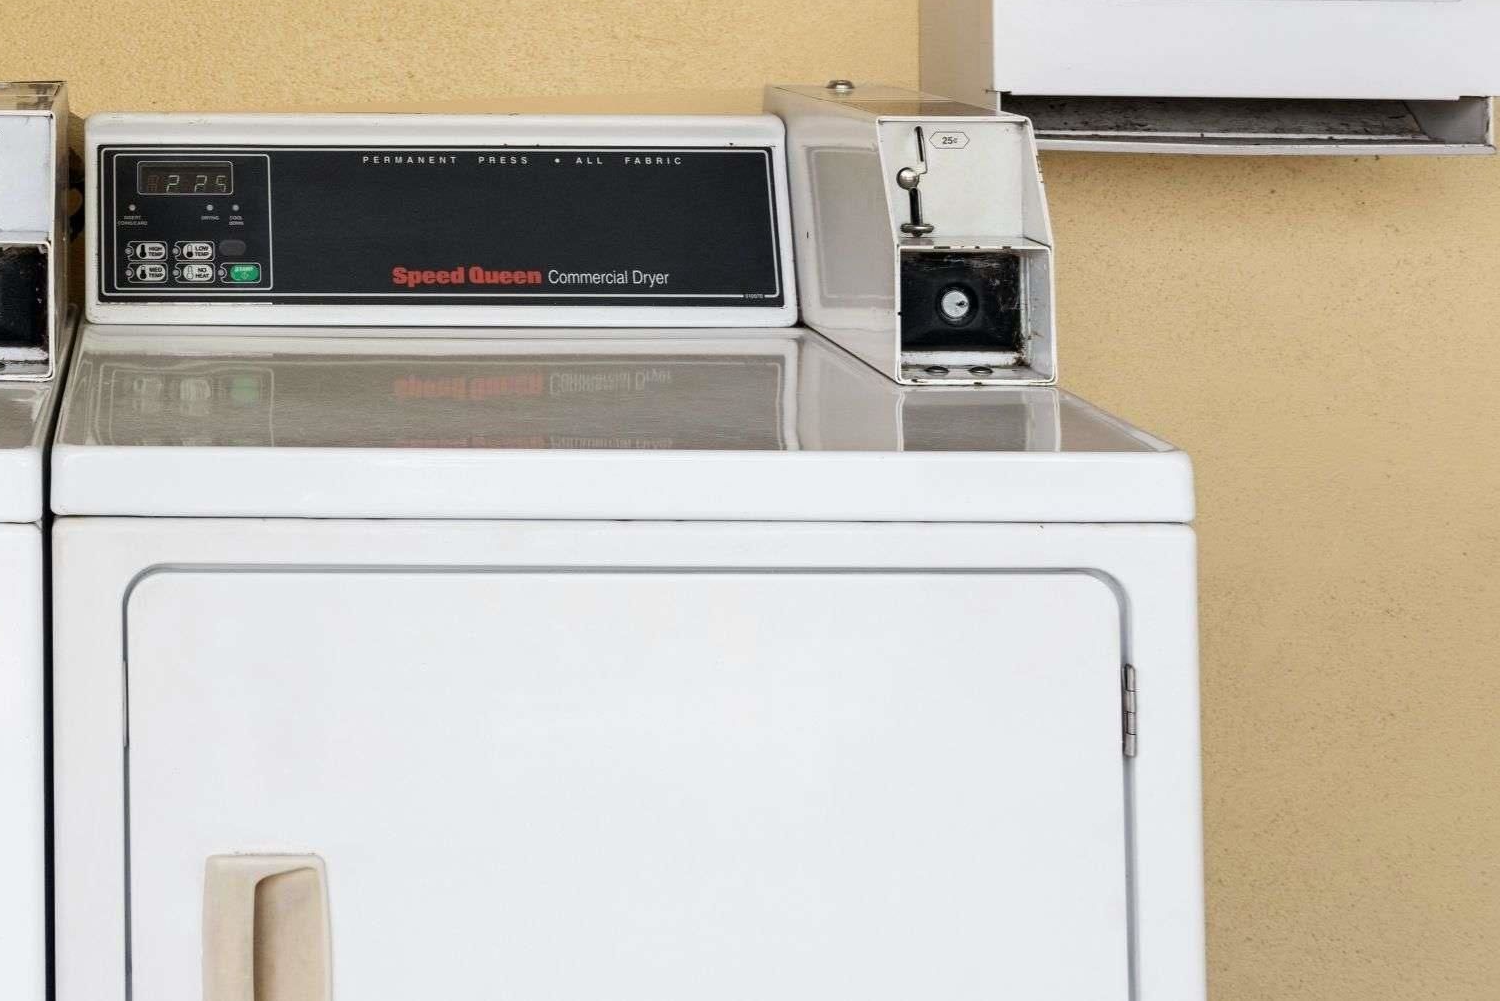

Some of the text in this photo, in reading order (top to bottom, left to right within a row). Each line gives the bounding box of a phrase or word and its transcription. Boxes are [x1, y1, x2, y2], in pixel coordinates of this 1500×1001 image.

[362, 156, 683, 166] PERMANENT PRESS ALL FABRIC
[392, 267, 670, 288] Speed Queen Commercial Dryer
